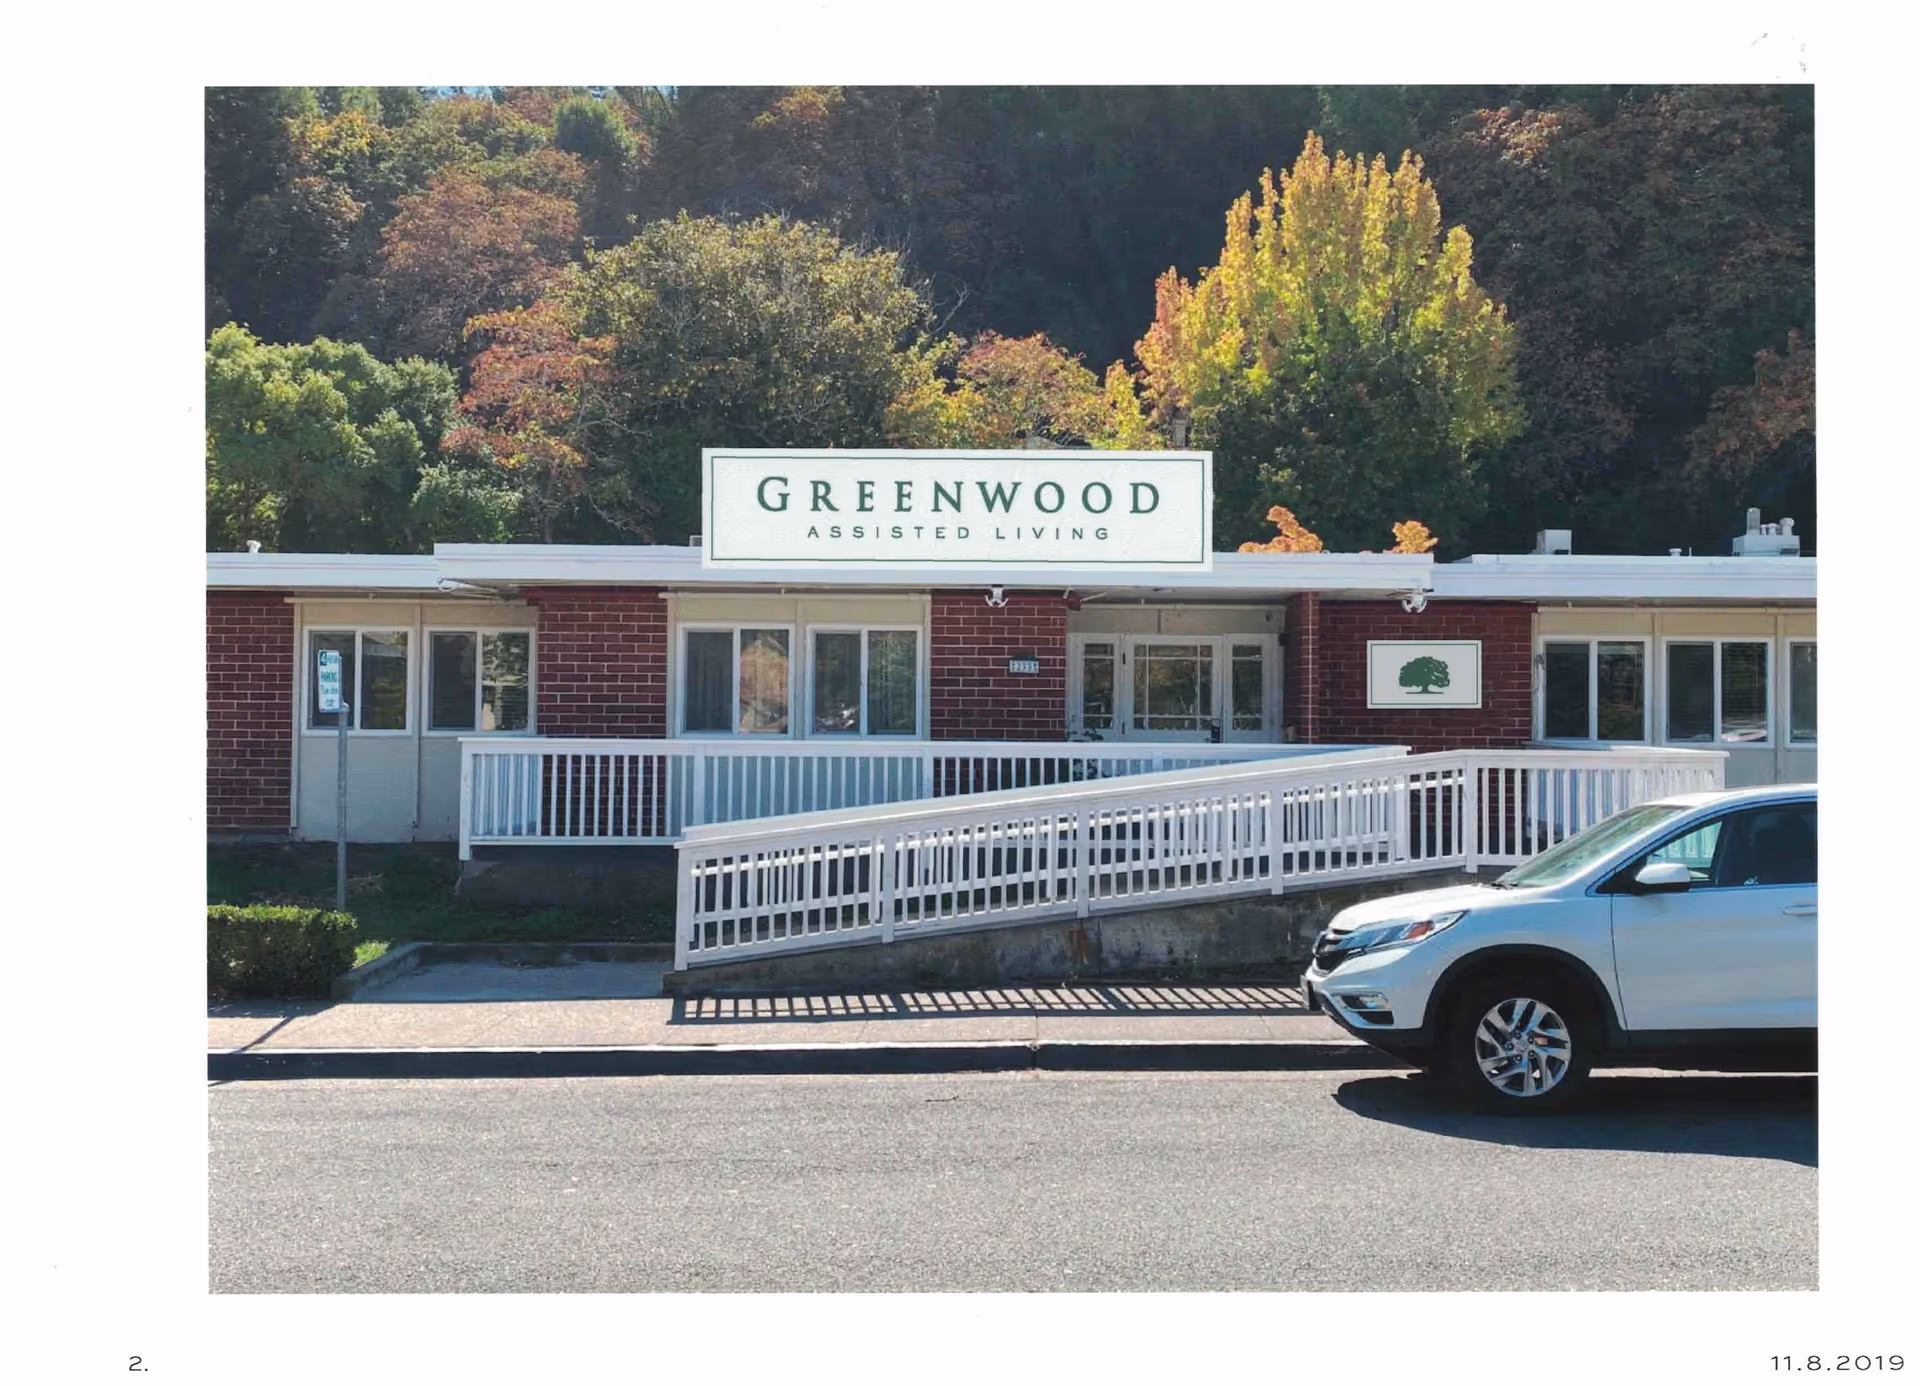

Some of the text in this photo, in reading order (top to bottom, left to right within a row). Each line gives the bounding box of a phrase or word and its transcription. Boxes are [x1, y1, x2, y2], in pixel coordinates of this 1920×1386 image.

[757, 475, 1160, 514] GREENWOOD
[807, 525, 1108, 541] ASSISTED LIVING
